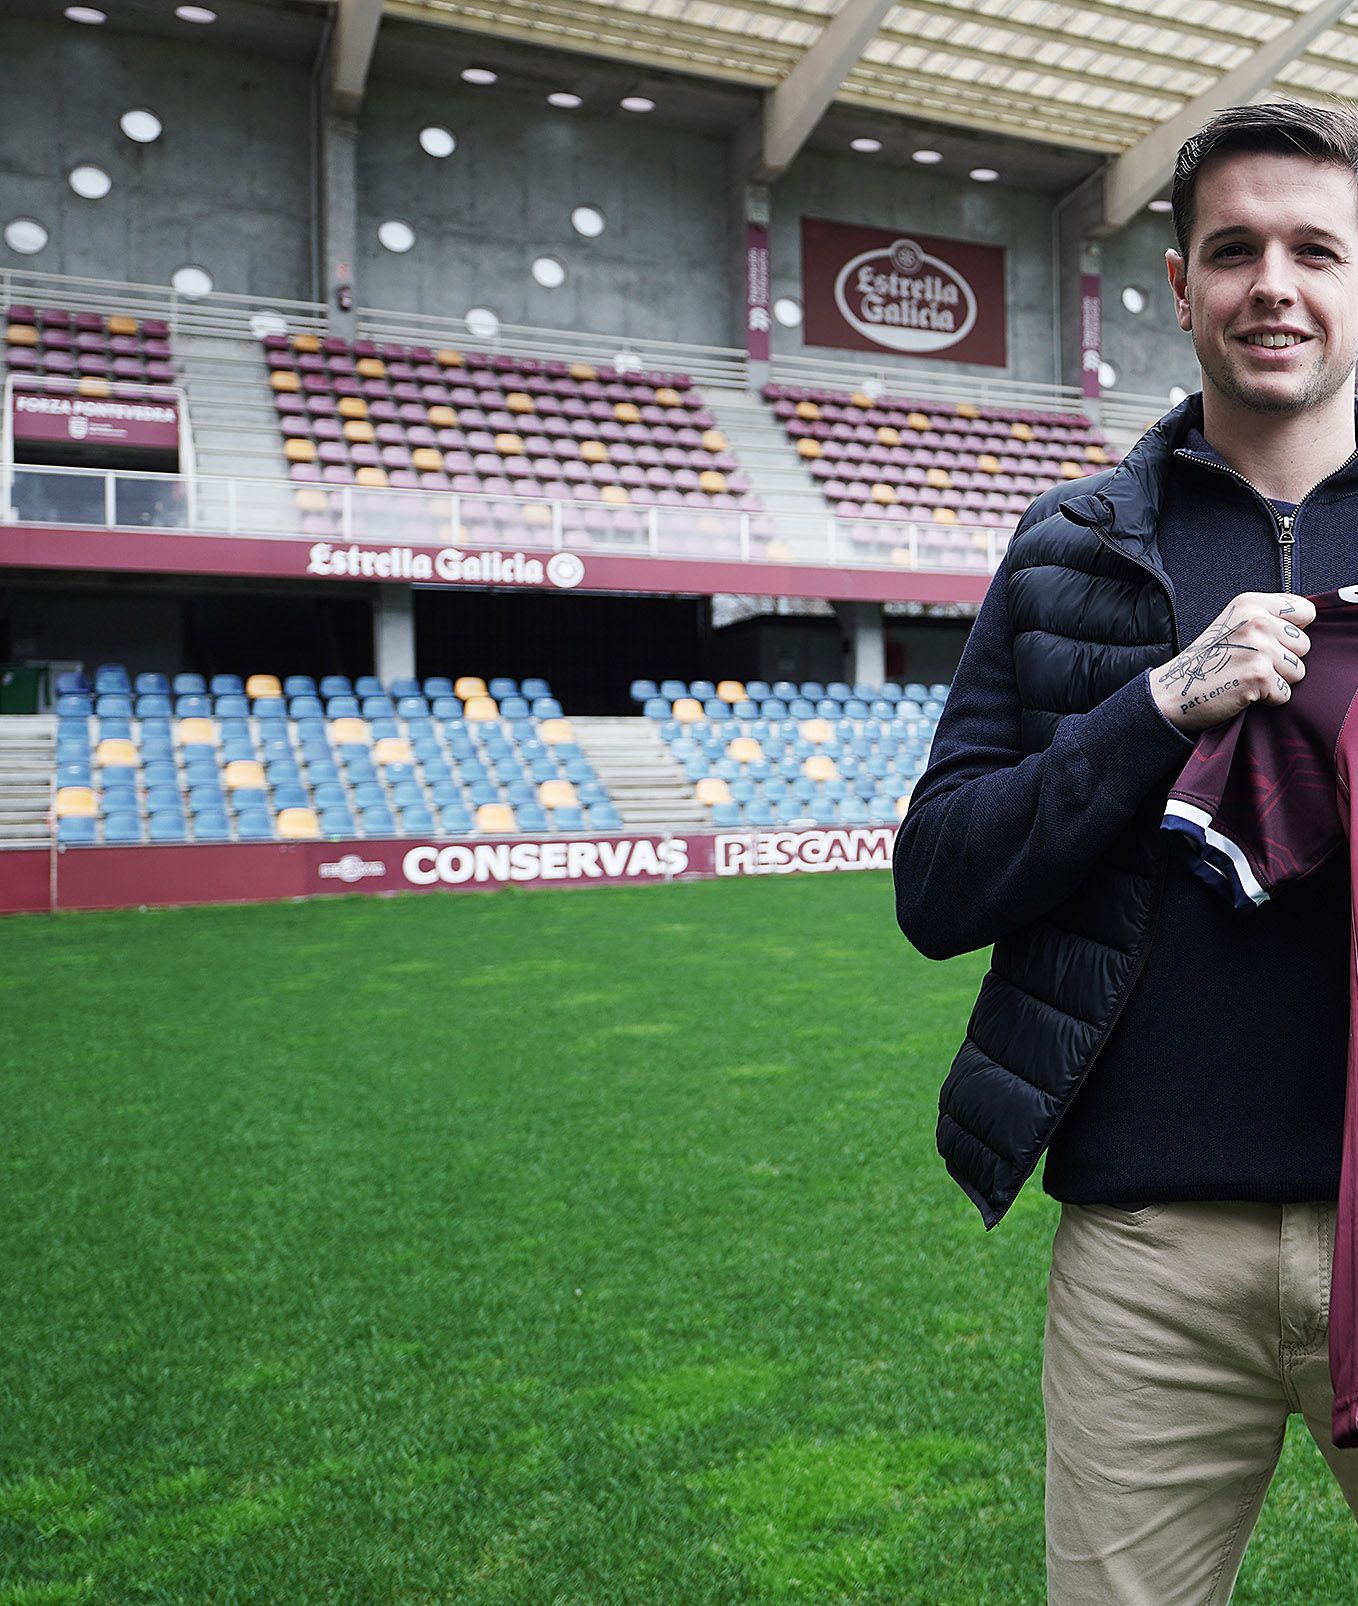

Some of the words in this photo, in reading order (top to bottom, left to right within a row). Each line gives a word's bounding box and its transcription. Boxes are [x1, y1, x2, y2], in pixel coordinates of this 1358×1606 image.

[855, 265, 960, 305] Estrella
[860, 291, 955, 332] Galicia
[306, 542, 433, 579] Estrella
[434, 547, 545, 584] Galicia
[1180, 677, 1241, 715] patience
[402, 839, 689, 886] CONSERVAS
[714, 828, 896, 877] PESCAM
